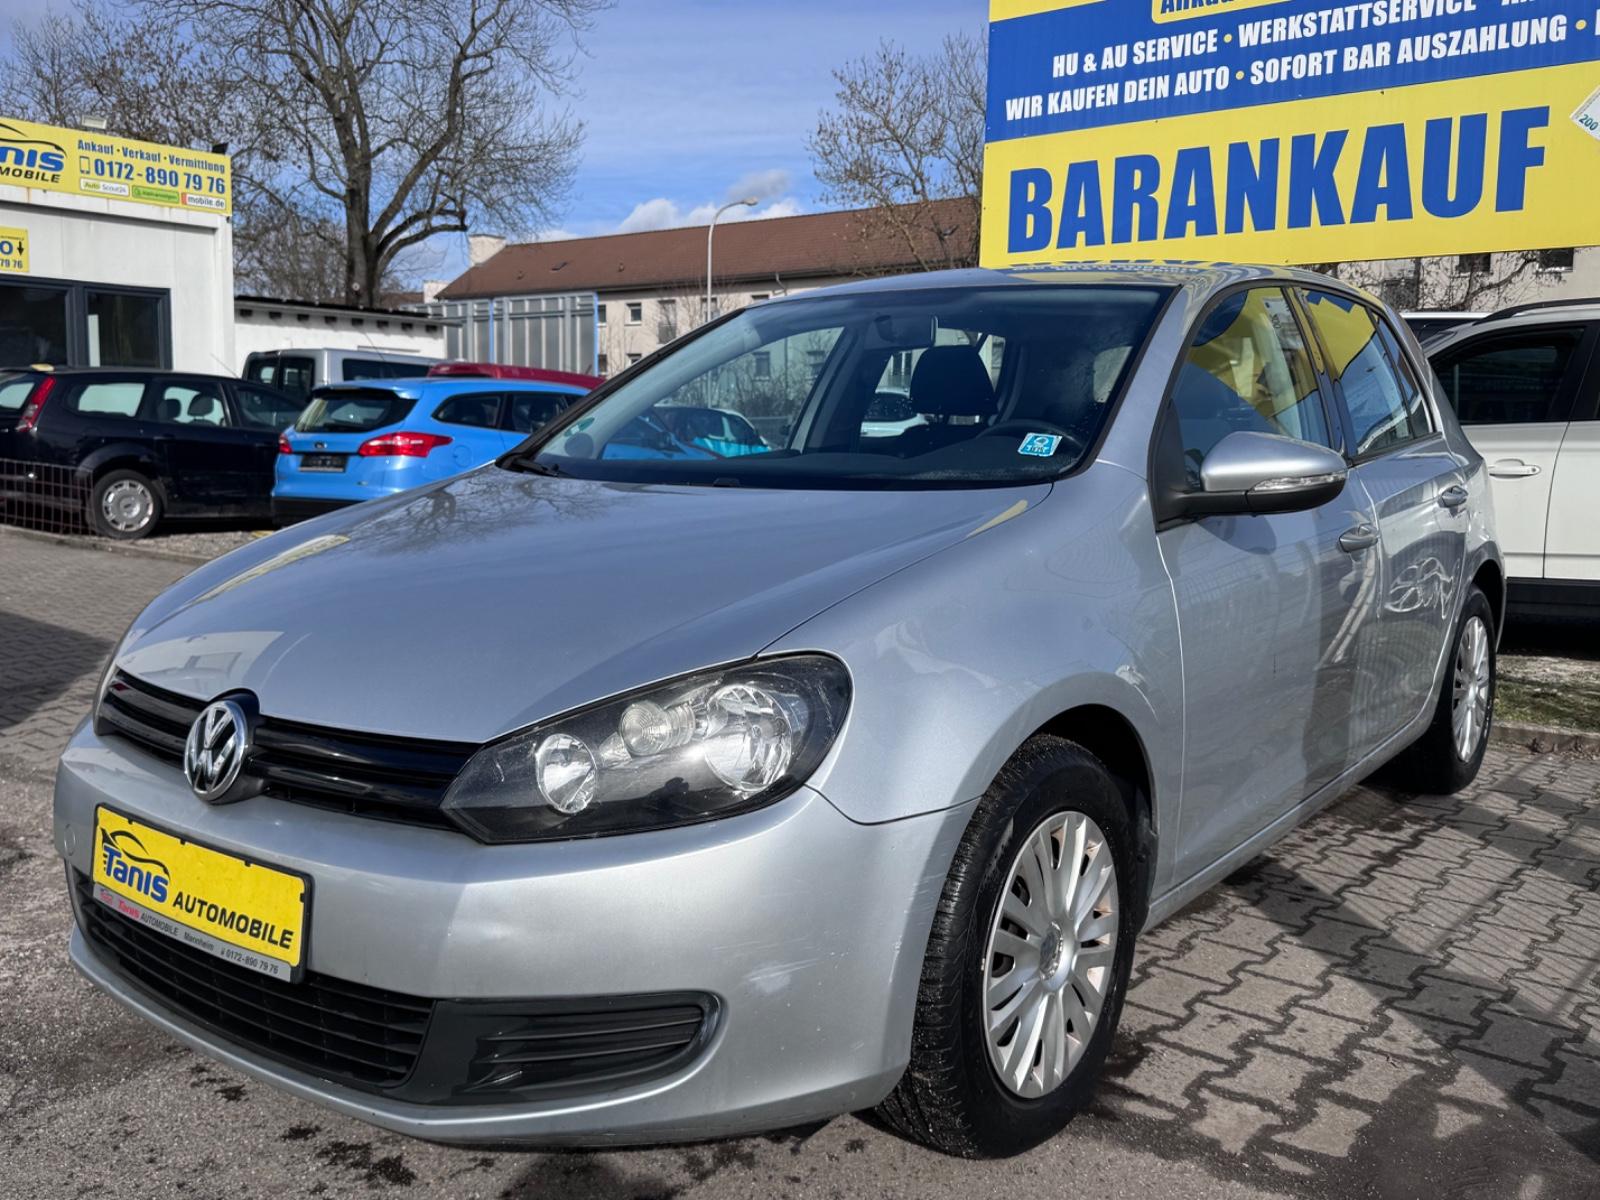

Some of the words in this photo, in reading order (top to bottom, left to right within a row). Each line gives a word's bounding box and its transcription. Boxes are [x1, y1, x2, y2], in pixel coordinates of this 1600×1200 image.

[1005, 94, 1043, 121] WIR
[1046, 82, 1119, 115] KAUFEN
[1123, 74, 1170, 104] DEIN
[1174, 65, 1230, 96] AUTO
[1250, 49, 1338, 85] SOFORT
[1342, 41, 1391, 72] BAR
[1396, 14, 1567, 65] AUSZAHLUNG
[1052, 52, 1079, 78] HU
[1082, 52, 1097, 73] &
[1101, 44, 1128, 71] AU
[1132, 28, 1218, 65] SERVICE
[1578, 113, 1599, 131] 200
[77, 139, 114, 155] Ankauf
[121, 146, 161, 163] Verkauf
[168, 154, 225, 174] Vermittlung
[183, 172, 202, 191] 79
[206, 175, 225, 194] 76
[1007, 105, 1550, 254] BARANKAUF
[141, 911, 179, 937] AUTOMOBILE
[172, 891, 294, 950] AUTOMOBILE
